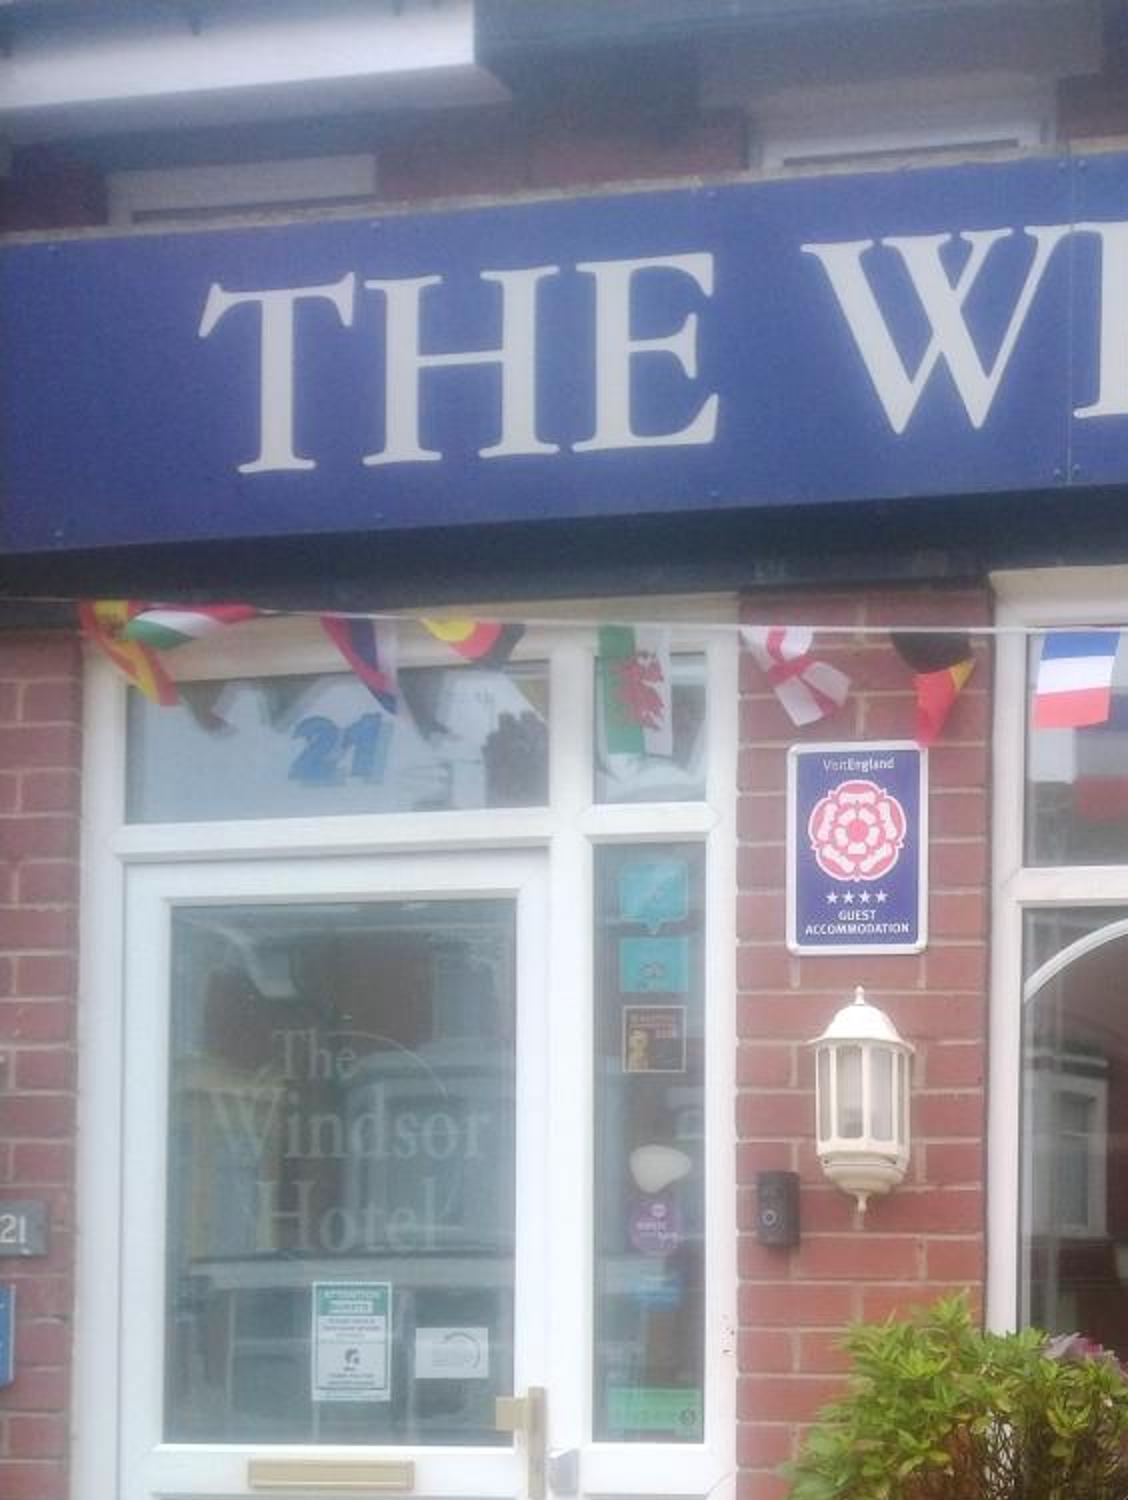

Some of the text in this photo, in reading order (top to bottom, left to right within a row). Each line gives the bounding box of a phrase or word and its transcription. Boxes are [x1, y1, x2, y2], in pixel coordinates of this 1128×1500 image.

[198, 251, 720, 475] THE
[288, 713, 388, 787] 21
[804, 921, 910, 937] ACCOMMODATION
[838, 909, 877, 922] GUEST
[271, 1026, 359, 1081] The
[204, 1086, 493, 1160] Windsor
[255, 1178, 440, 1253] Hotel
